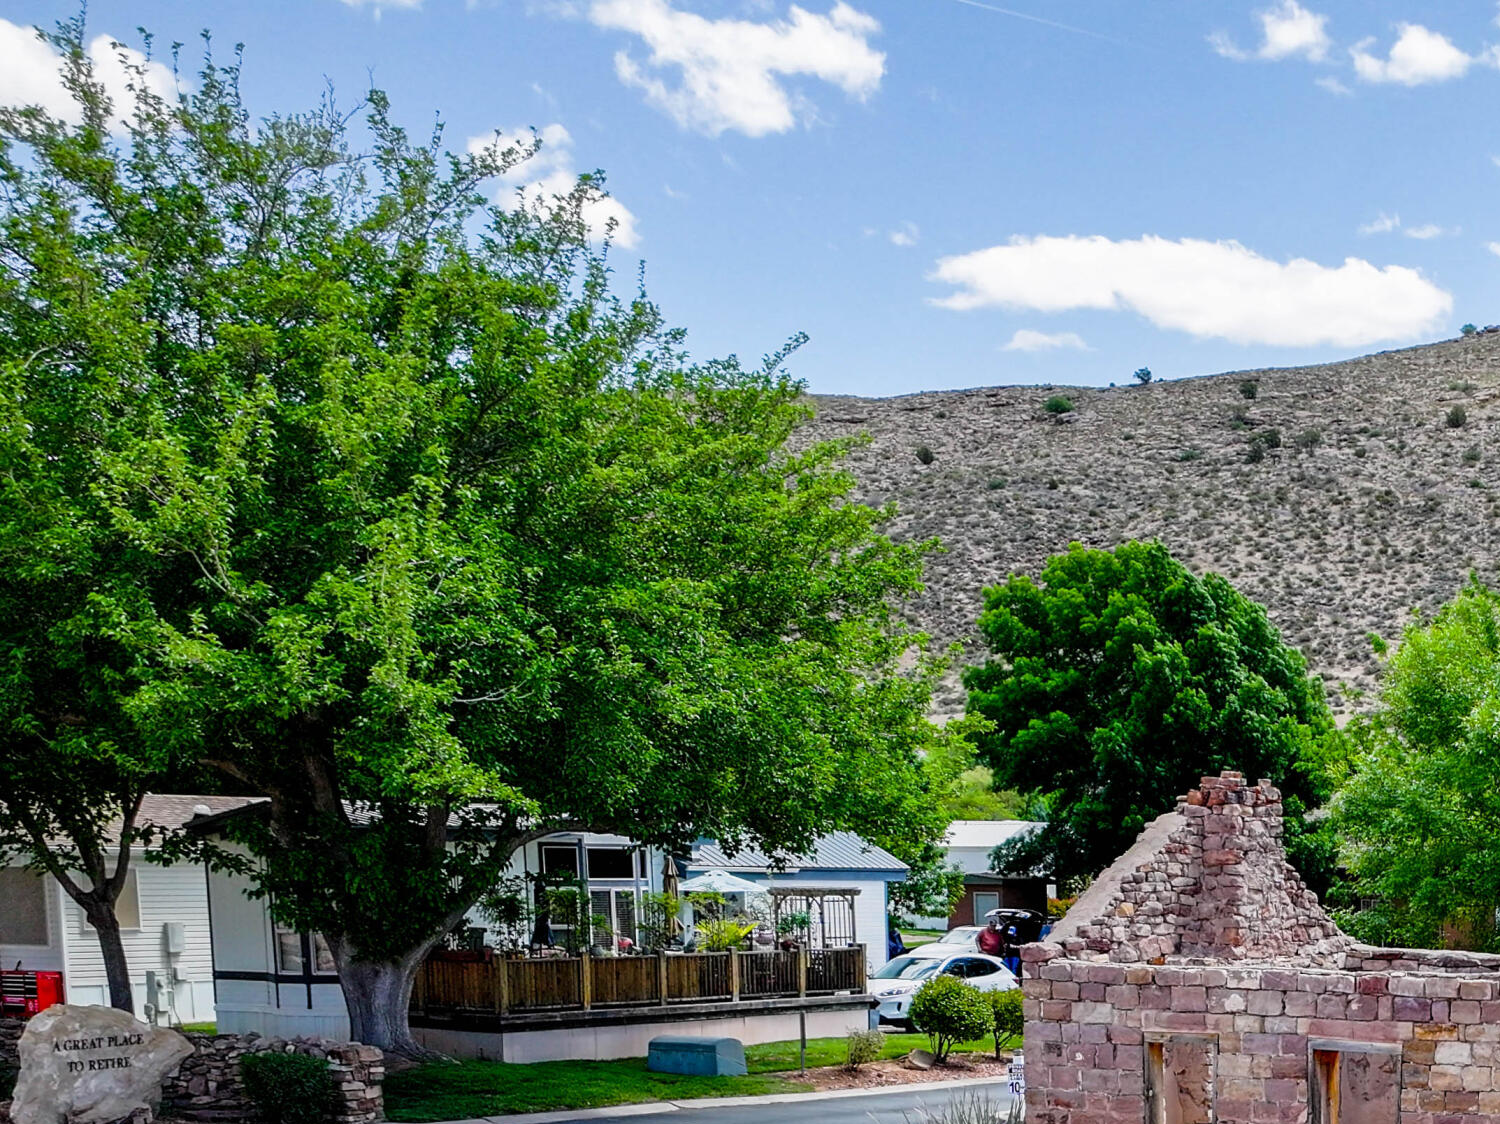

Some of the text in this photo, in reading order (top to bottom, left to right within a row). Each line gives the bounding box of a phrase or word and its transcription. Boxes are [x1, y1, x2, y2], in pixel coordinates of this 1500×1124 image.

[53, 1034, 145, 1053] A GREAT PLACE
[67, 1057, 133, 1073] TO RETIRE
